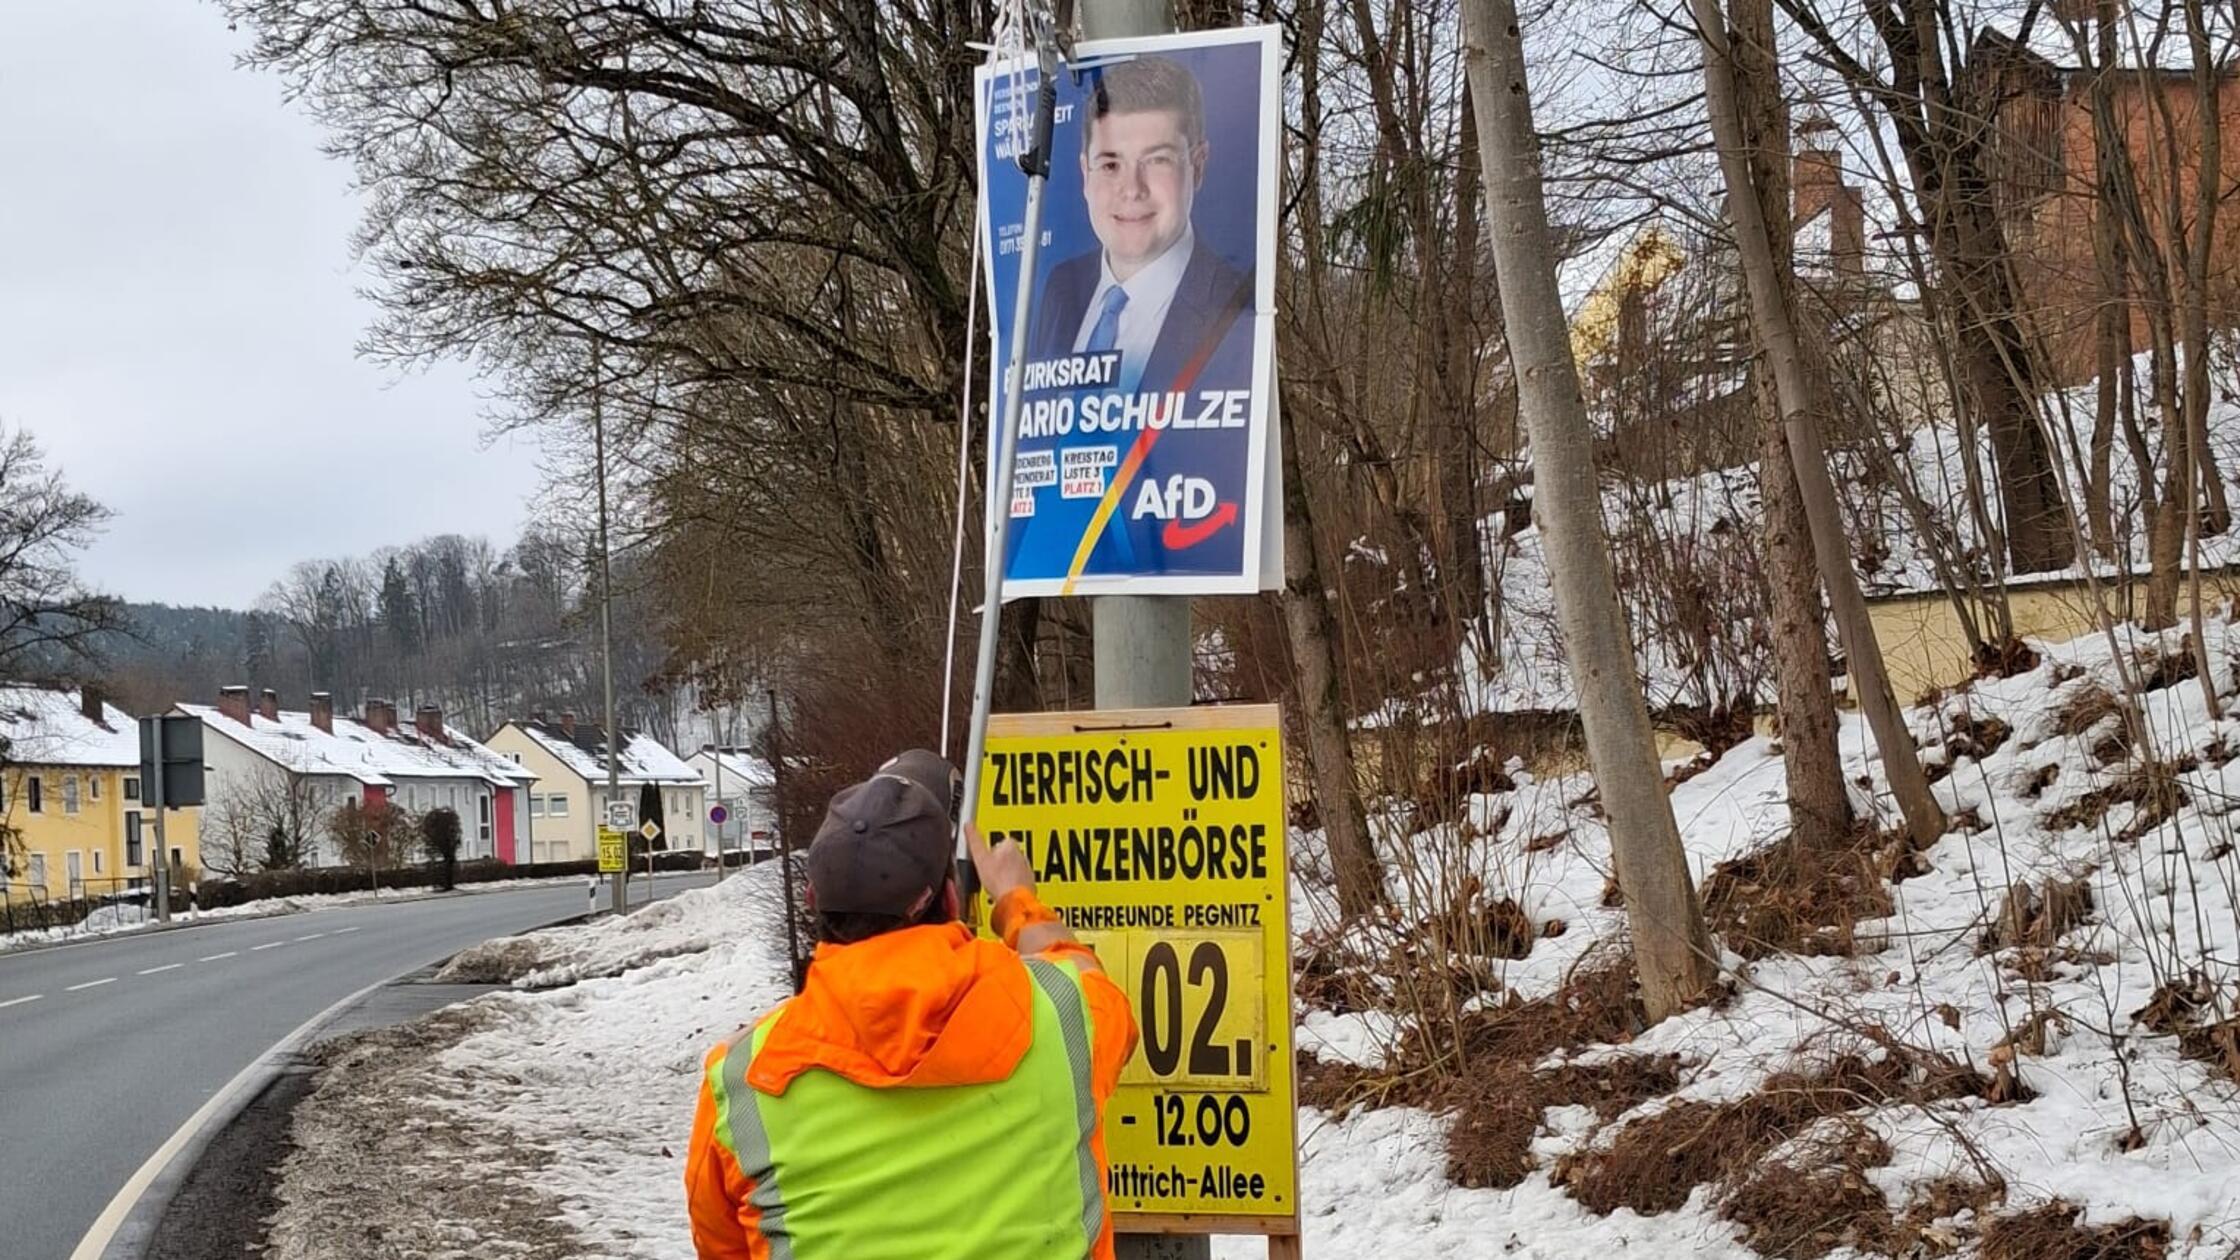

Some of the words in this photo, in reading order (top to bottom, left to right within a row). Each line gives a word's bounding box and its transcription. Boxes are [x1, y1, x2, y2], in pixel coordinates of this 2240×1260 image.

[1018, 397, 1074, 440] ARIO
[1079, 389, 1251, 433] SCHULZE
[1016, 454, 1052, 469] DENBERG
[1064, 450, 1115, 464] KREISTAG
[1064, 467, 1092, 479] LISTE
[1064, 482, 1096, 495] PLATZ
[1131, 473, 1216, 519] AfD
[991, 748, 1170, 806] ZIERFISCH-
[1188, 745, 1259, 801] UND
[1055, 904, 1174, 928] IENFREUNDE
[1184, 903, 1261, 927] PEGNITZ
[1141, 941, 1252, 1077] 02.
[1154, 1094, 1251, 1147] 12.00
[1108, 1164, 1265, 1199] ittrich-Allee
